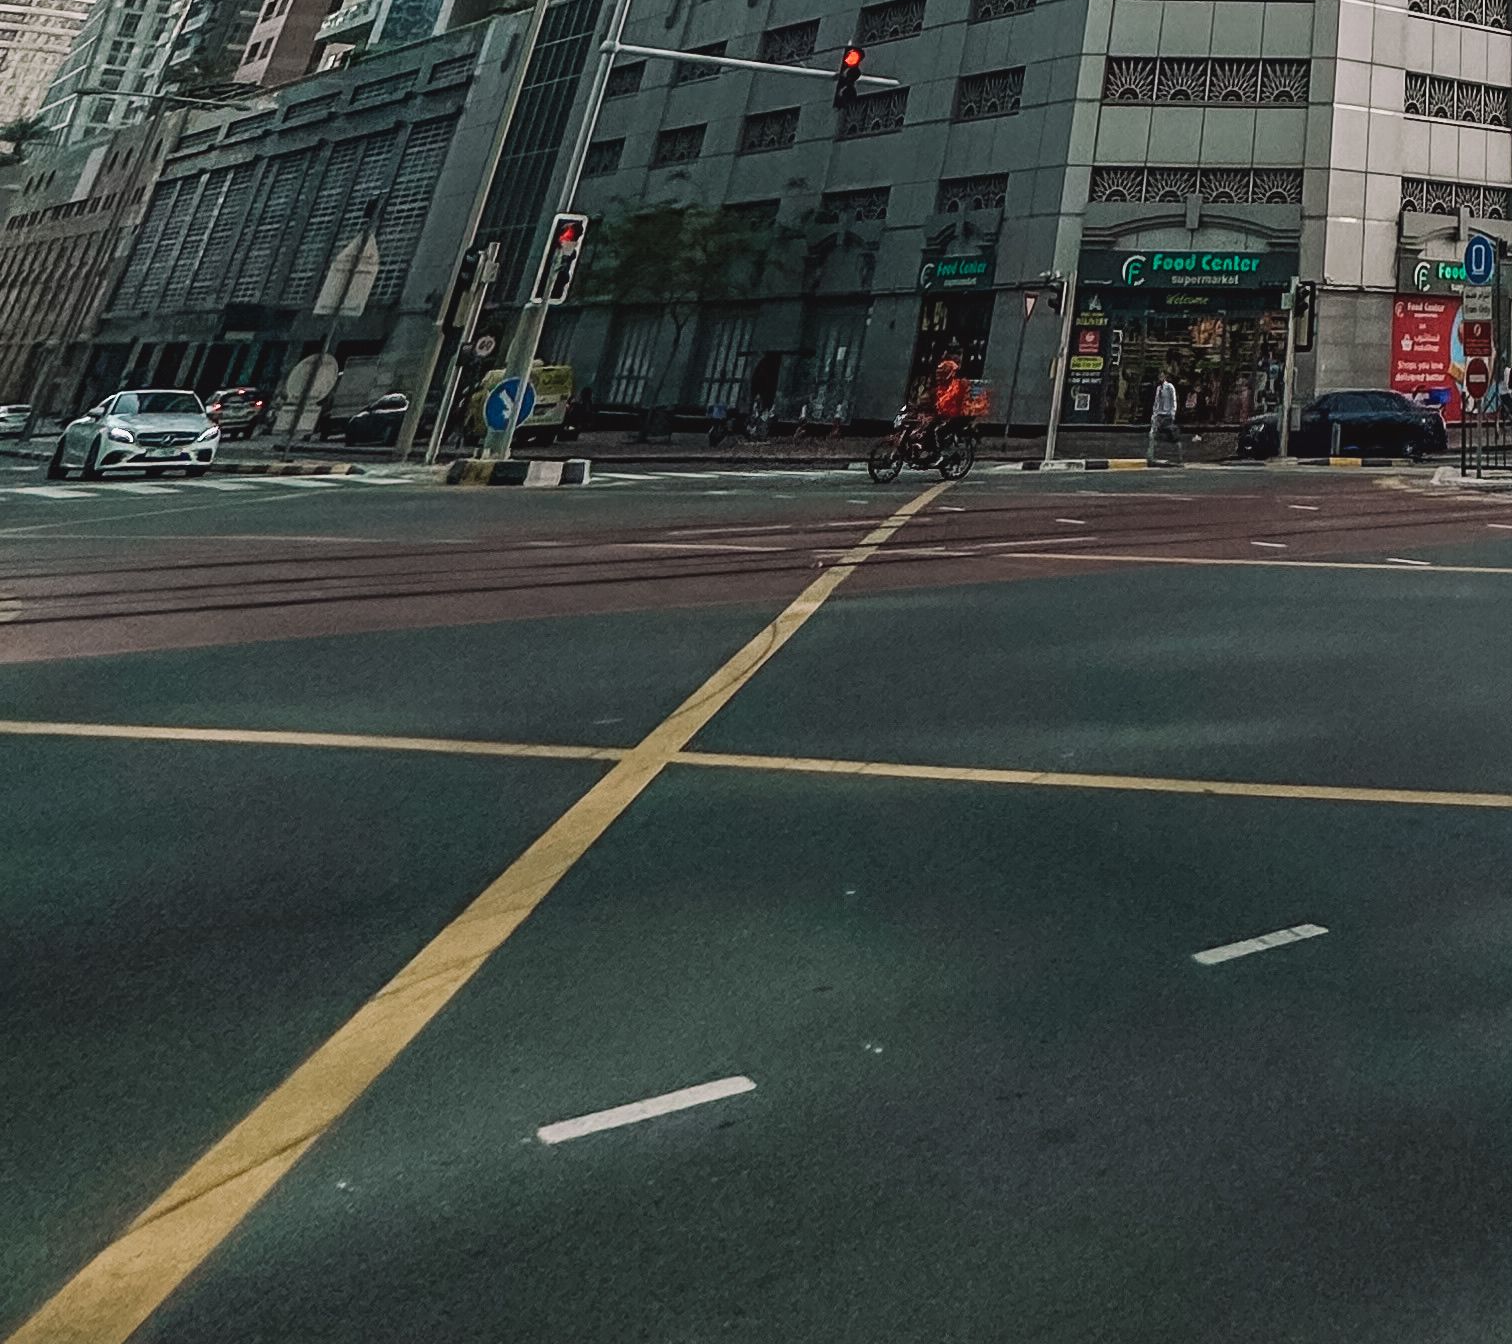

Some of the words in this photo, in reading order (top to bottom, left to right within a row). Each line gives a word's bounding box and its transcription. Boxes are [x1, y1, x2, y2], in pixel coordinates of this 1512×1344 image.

[1153, 253, 1197, 271] Food
[1201, 254, 1261, 272] Center
[1171, 274, 1239, 287] supermarket
